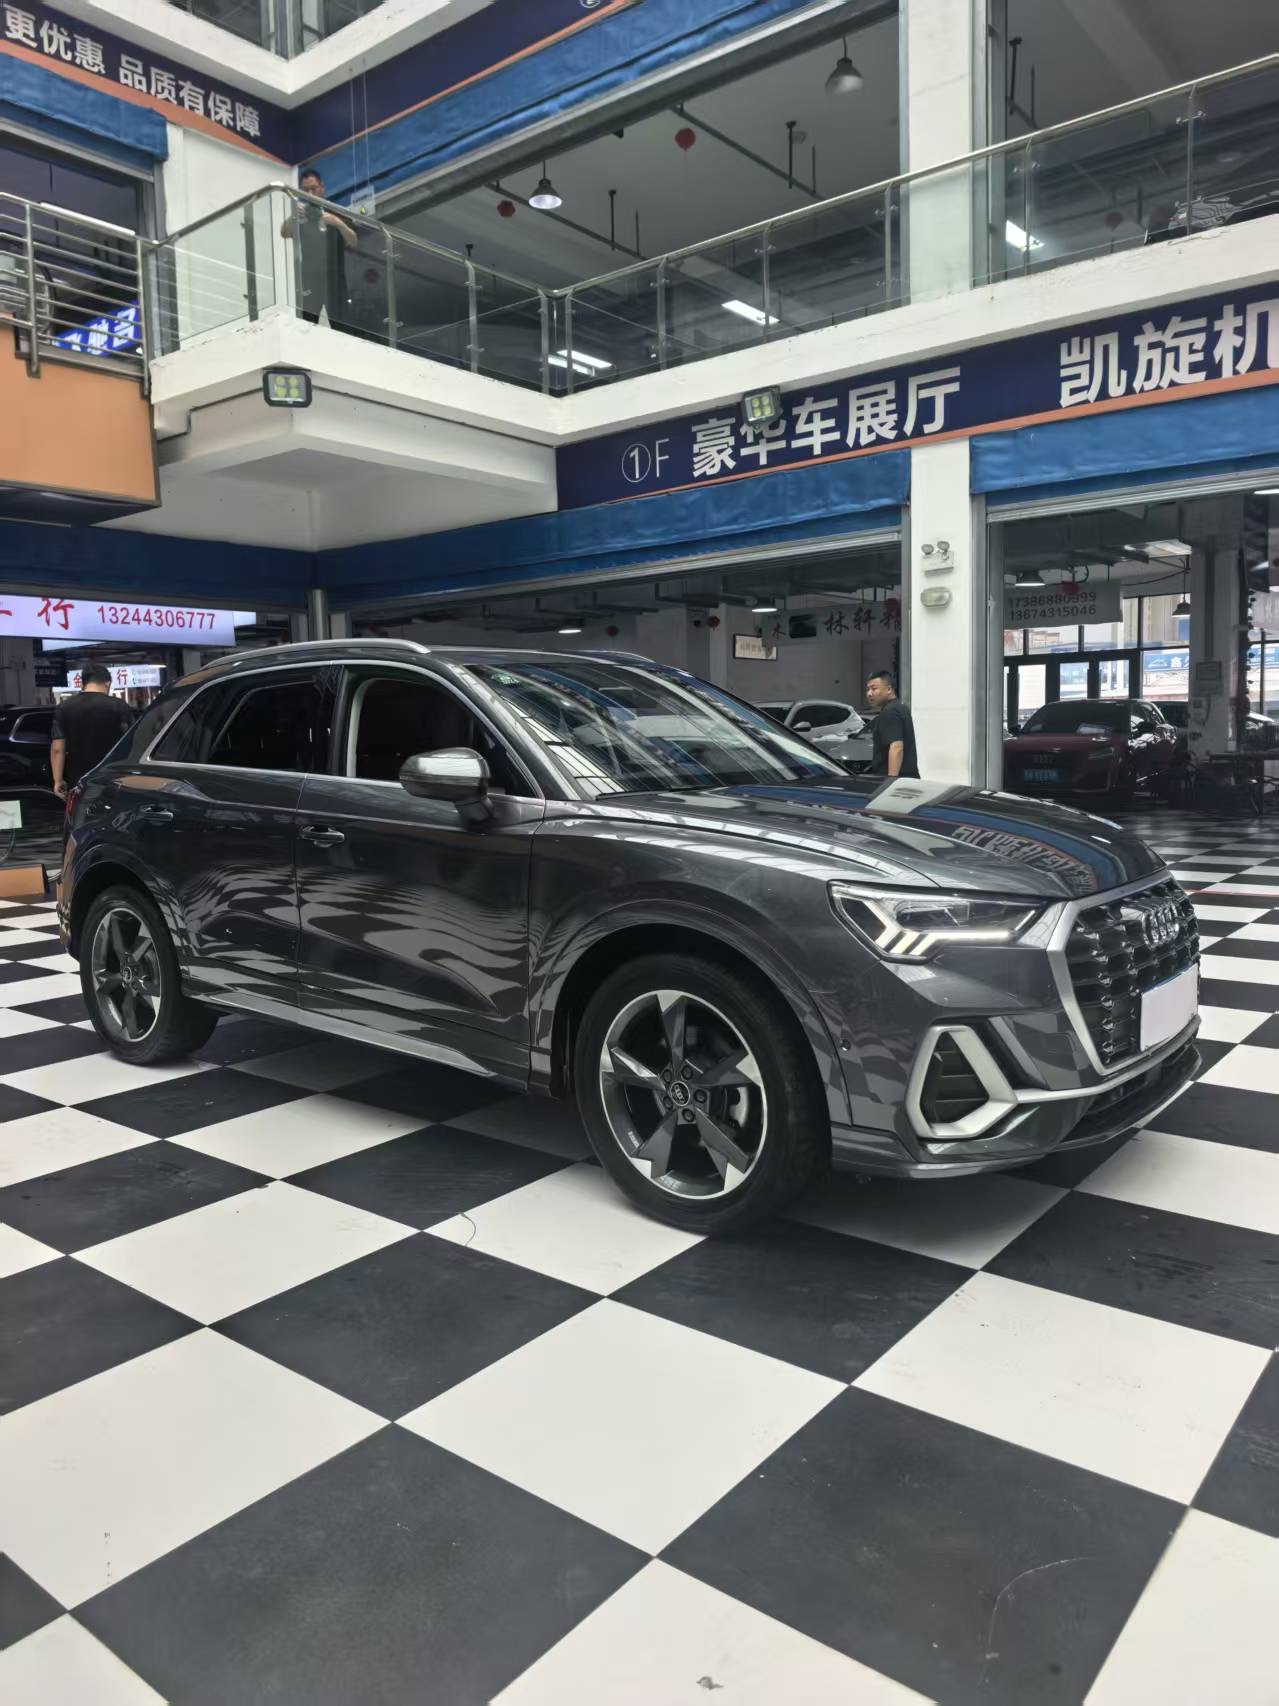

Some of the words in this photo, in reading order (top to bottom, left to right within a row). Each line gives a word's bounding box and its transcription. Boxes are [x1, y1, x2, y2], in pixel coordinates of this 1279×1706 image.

[4, 5, 106, 75] 更优惠
[118, 54, 261, 137] 品质有保障
[691, 366, 961, 478] 豪华车展厅
[1059, 298, 1279, 408] 凯旋机
[37, 597, 75, 630] 行
[97, 605, 216, 630] 13244306777
